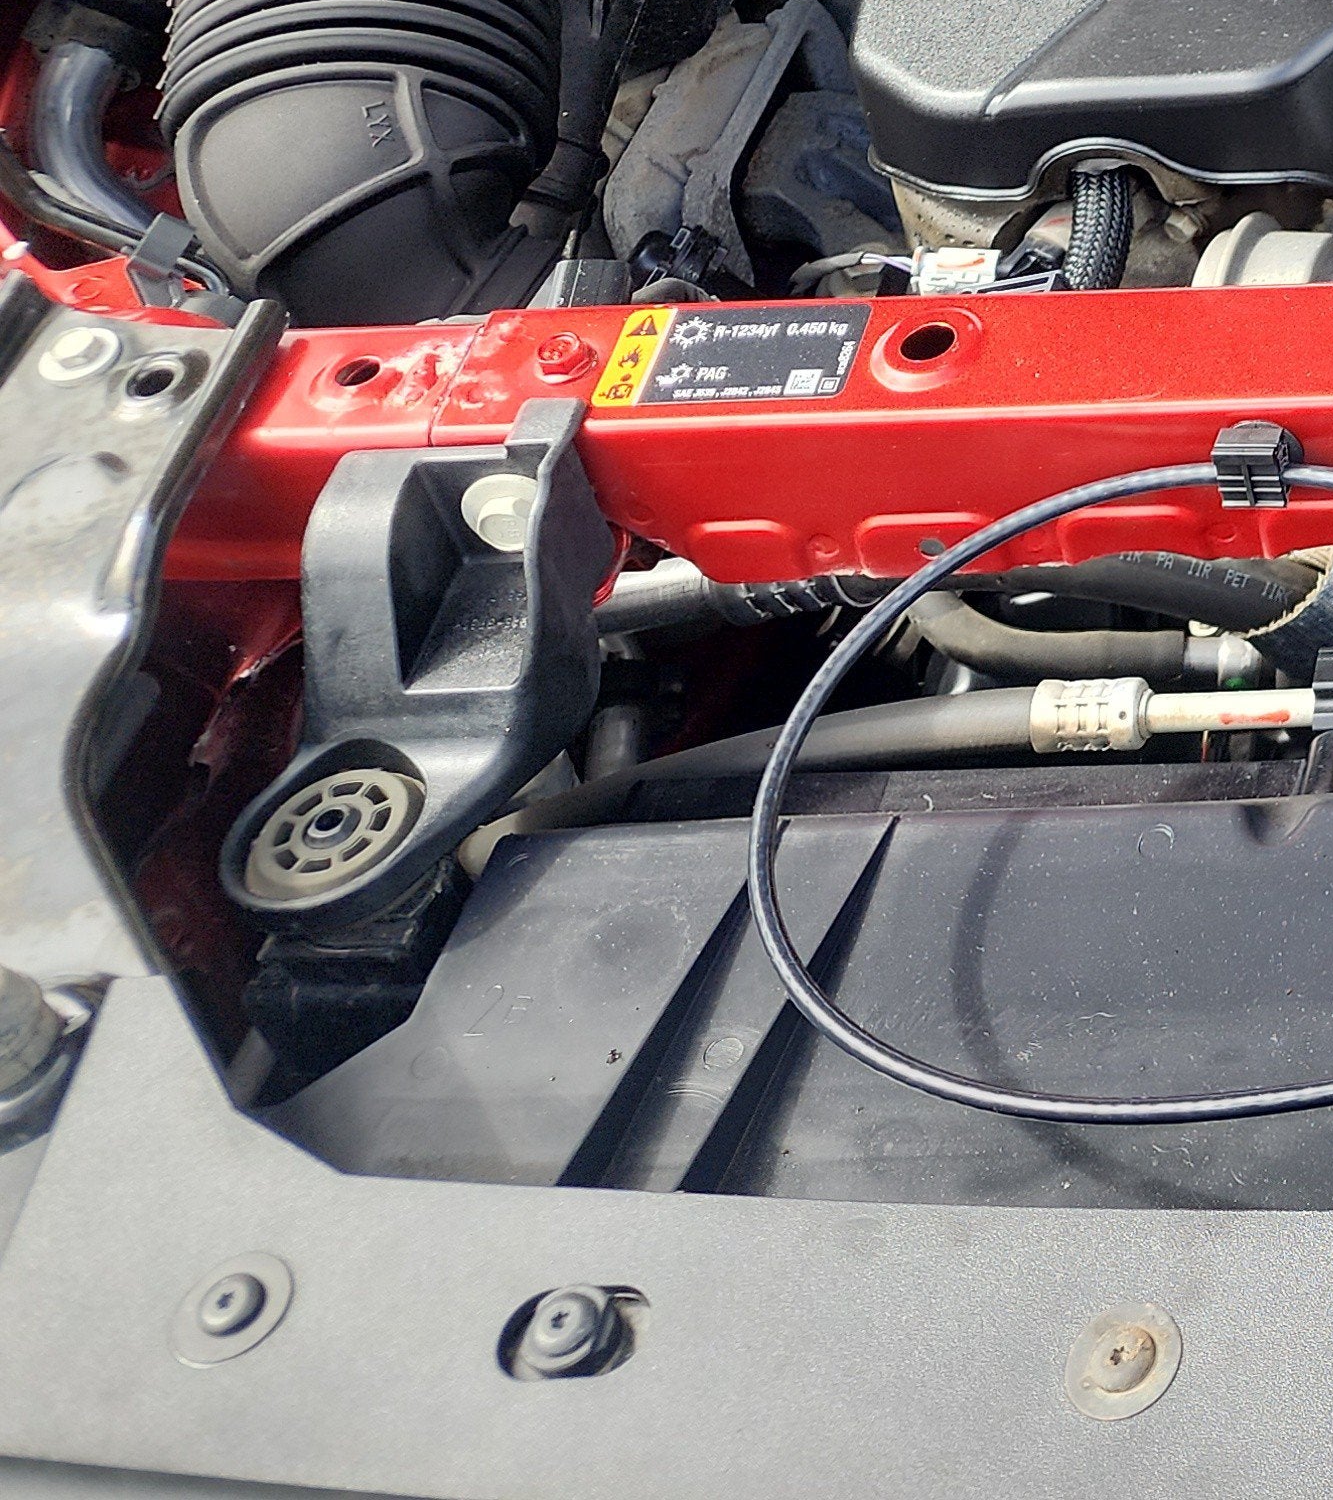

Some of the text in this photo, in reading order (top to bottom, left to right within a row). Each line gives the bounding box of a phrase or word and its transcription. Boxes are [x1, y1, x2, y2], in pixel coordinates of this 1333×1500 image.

[361, 101, 395, 148] LYX
[828, 321, 849, 336] kg
[695, 366, 729, 382] PAG
[1223, 569, 1251, 589] PET
